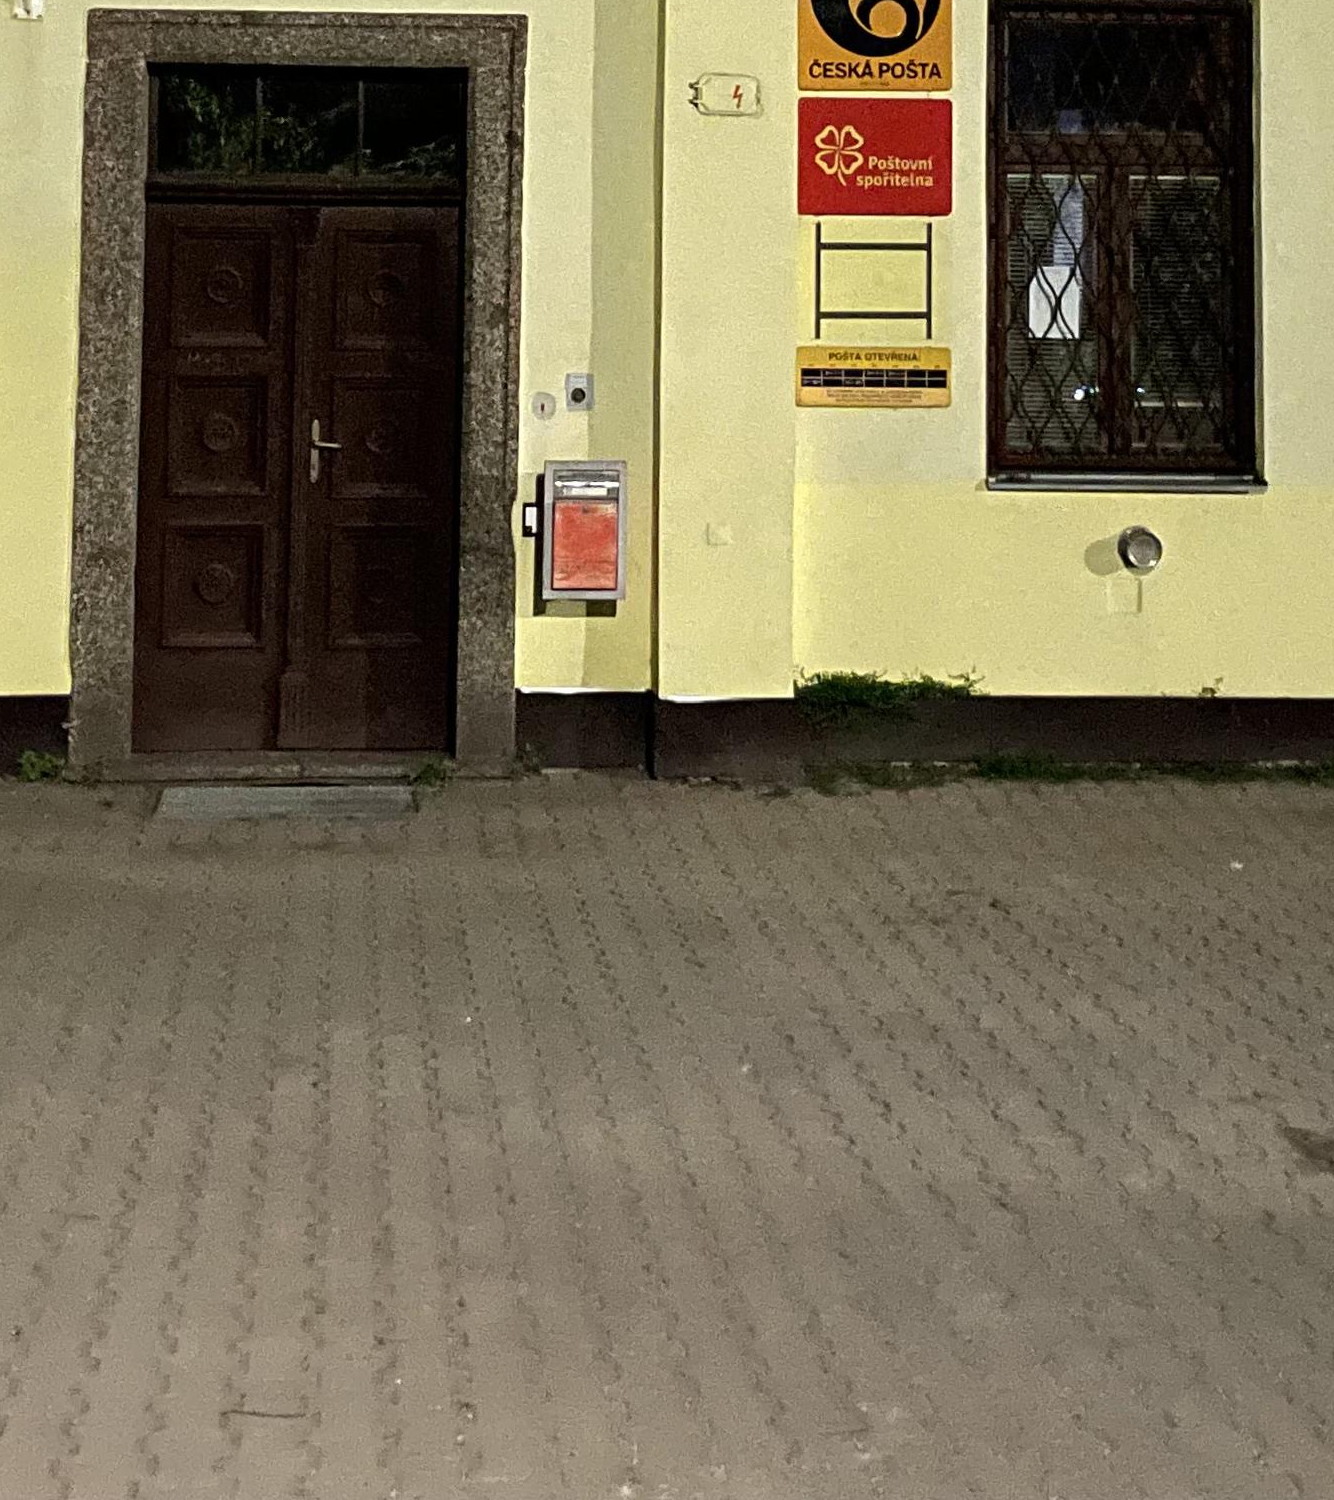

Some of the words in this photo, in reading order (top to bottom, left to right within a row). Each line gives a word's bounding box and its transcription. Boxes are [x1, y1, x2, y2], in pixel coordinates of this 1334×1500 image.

[809, 59, 873, 78] ČESKÁ
[878, 59, 942, 79] POŠTA
[868, 155, 933, 170] Poštovní
[856, 172, 934, 190] spořitelna
[828, 350, 862, 361] POŠTA
